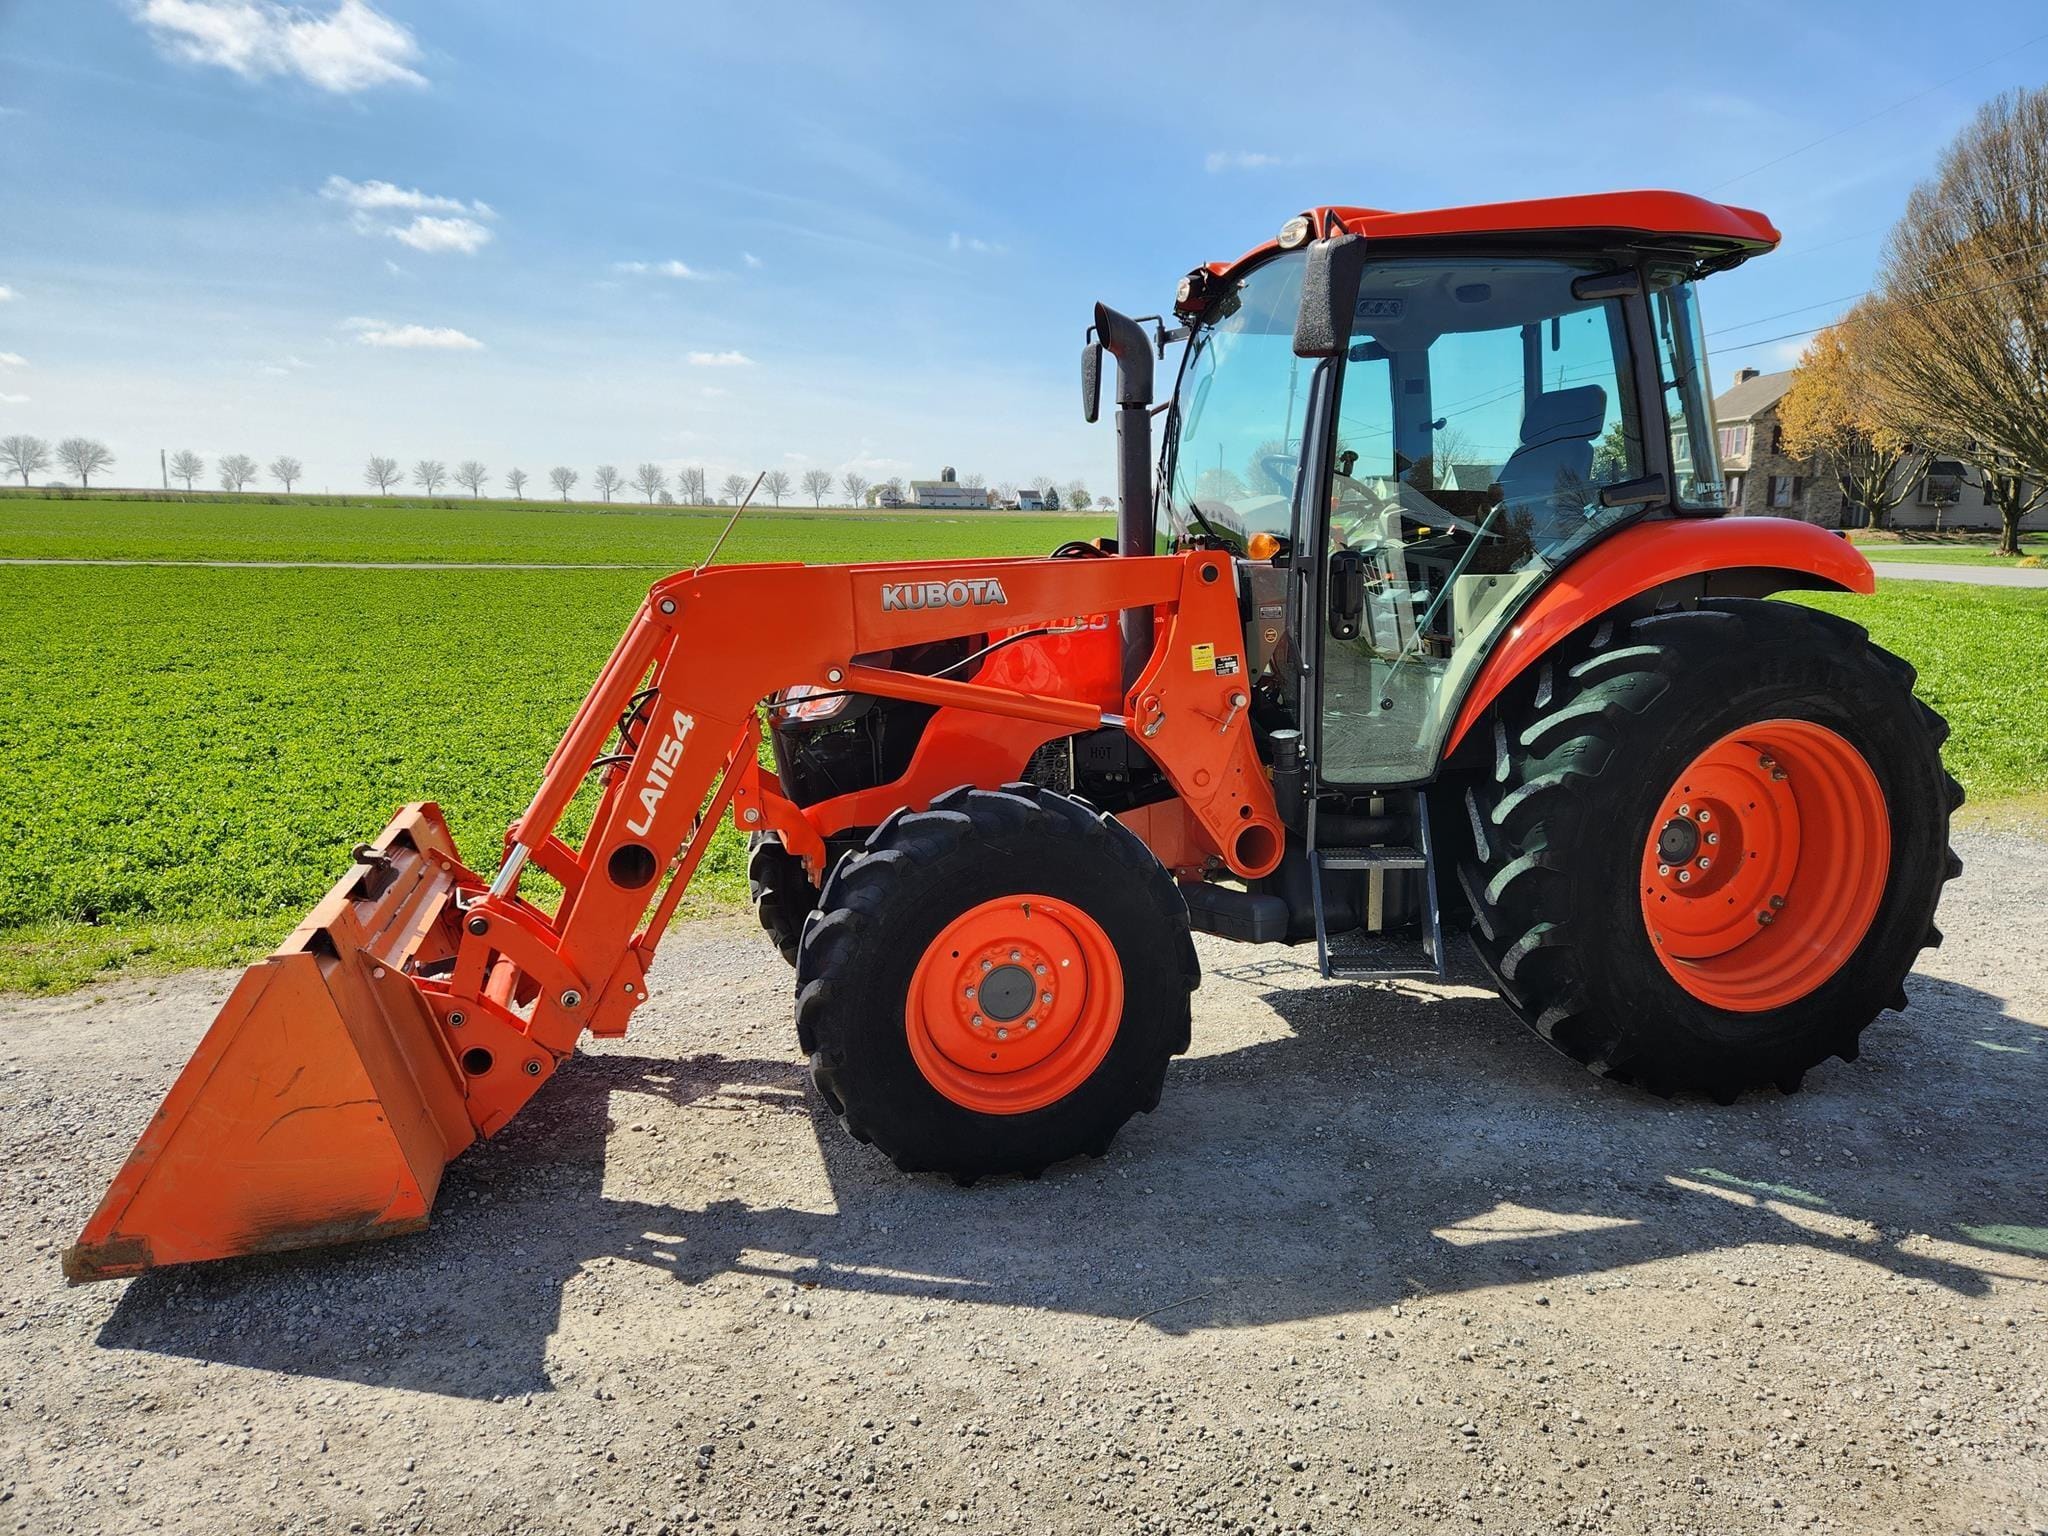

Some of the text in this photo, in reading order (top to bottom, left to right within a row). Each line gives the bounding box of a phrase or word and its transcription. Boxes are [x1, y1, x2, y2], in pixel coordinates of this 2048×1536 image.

[882, 579, 1007, 611] KUBOTA
[1090, 746, 1112, 759] HOT
[626, 710, 694, 836] LA1154
